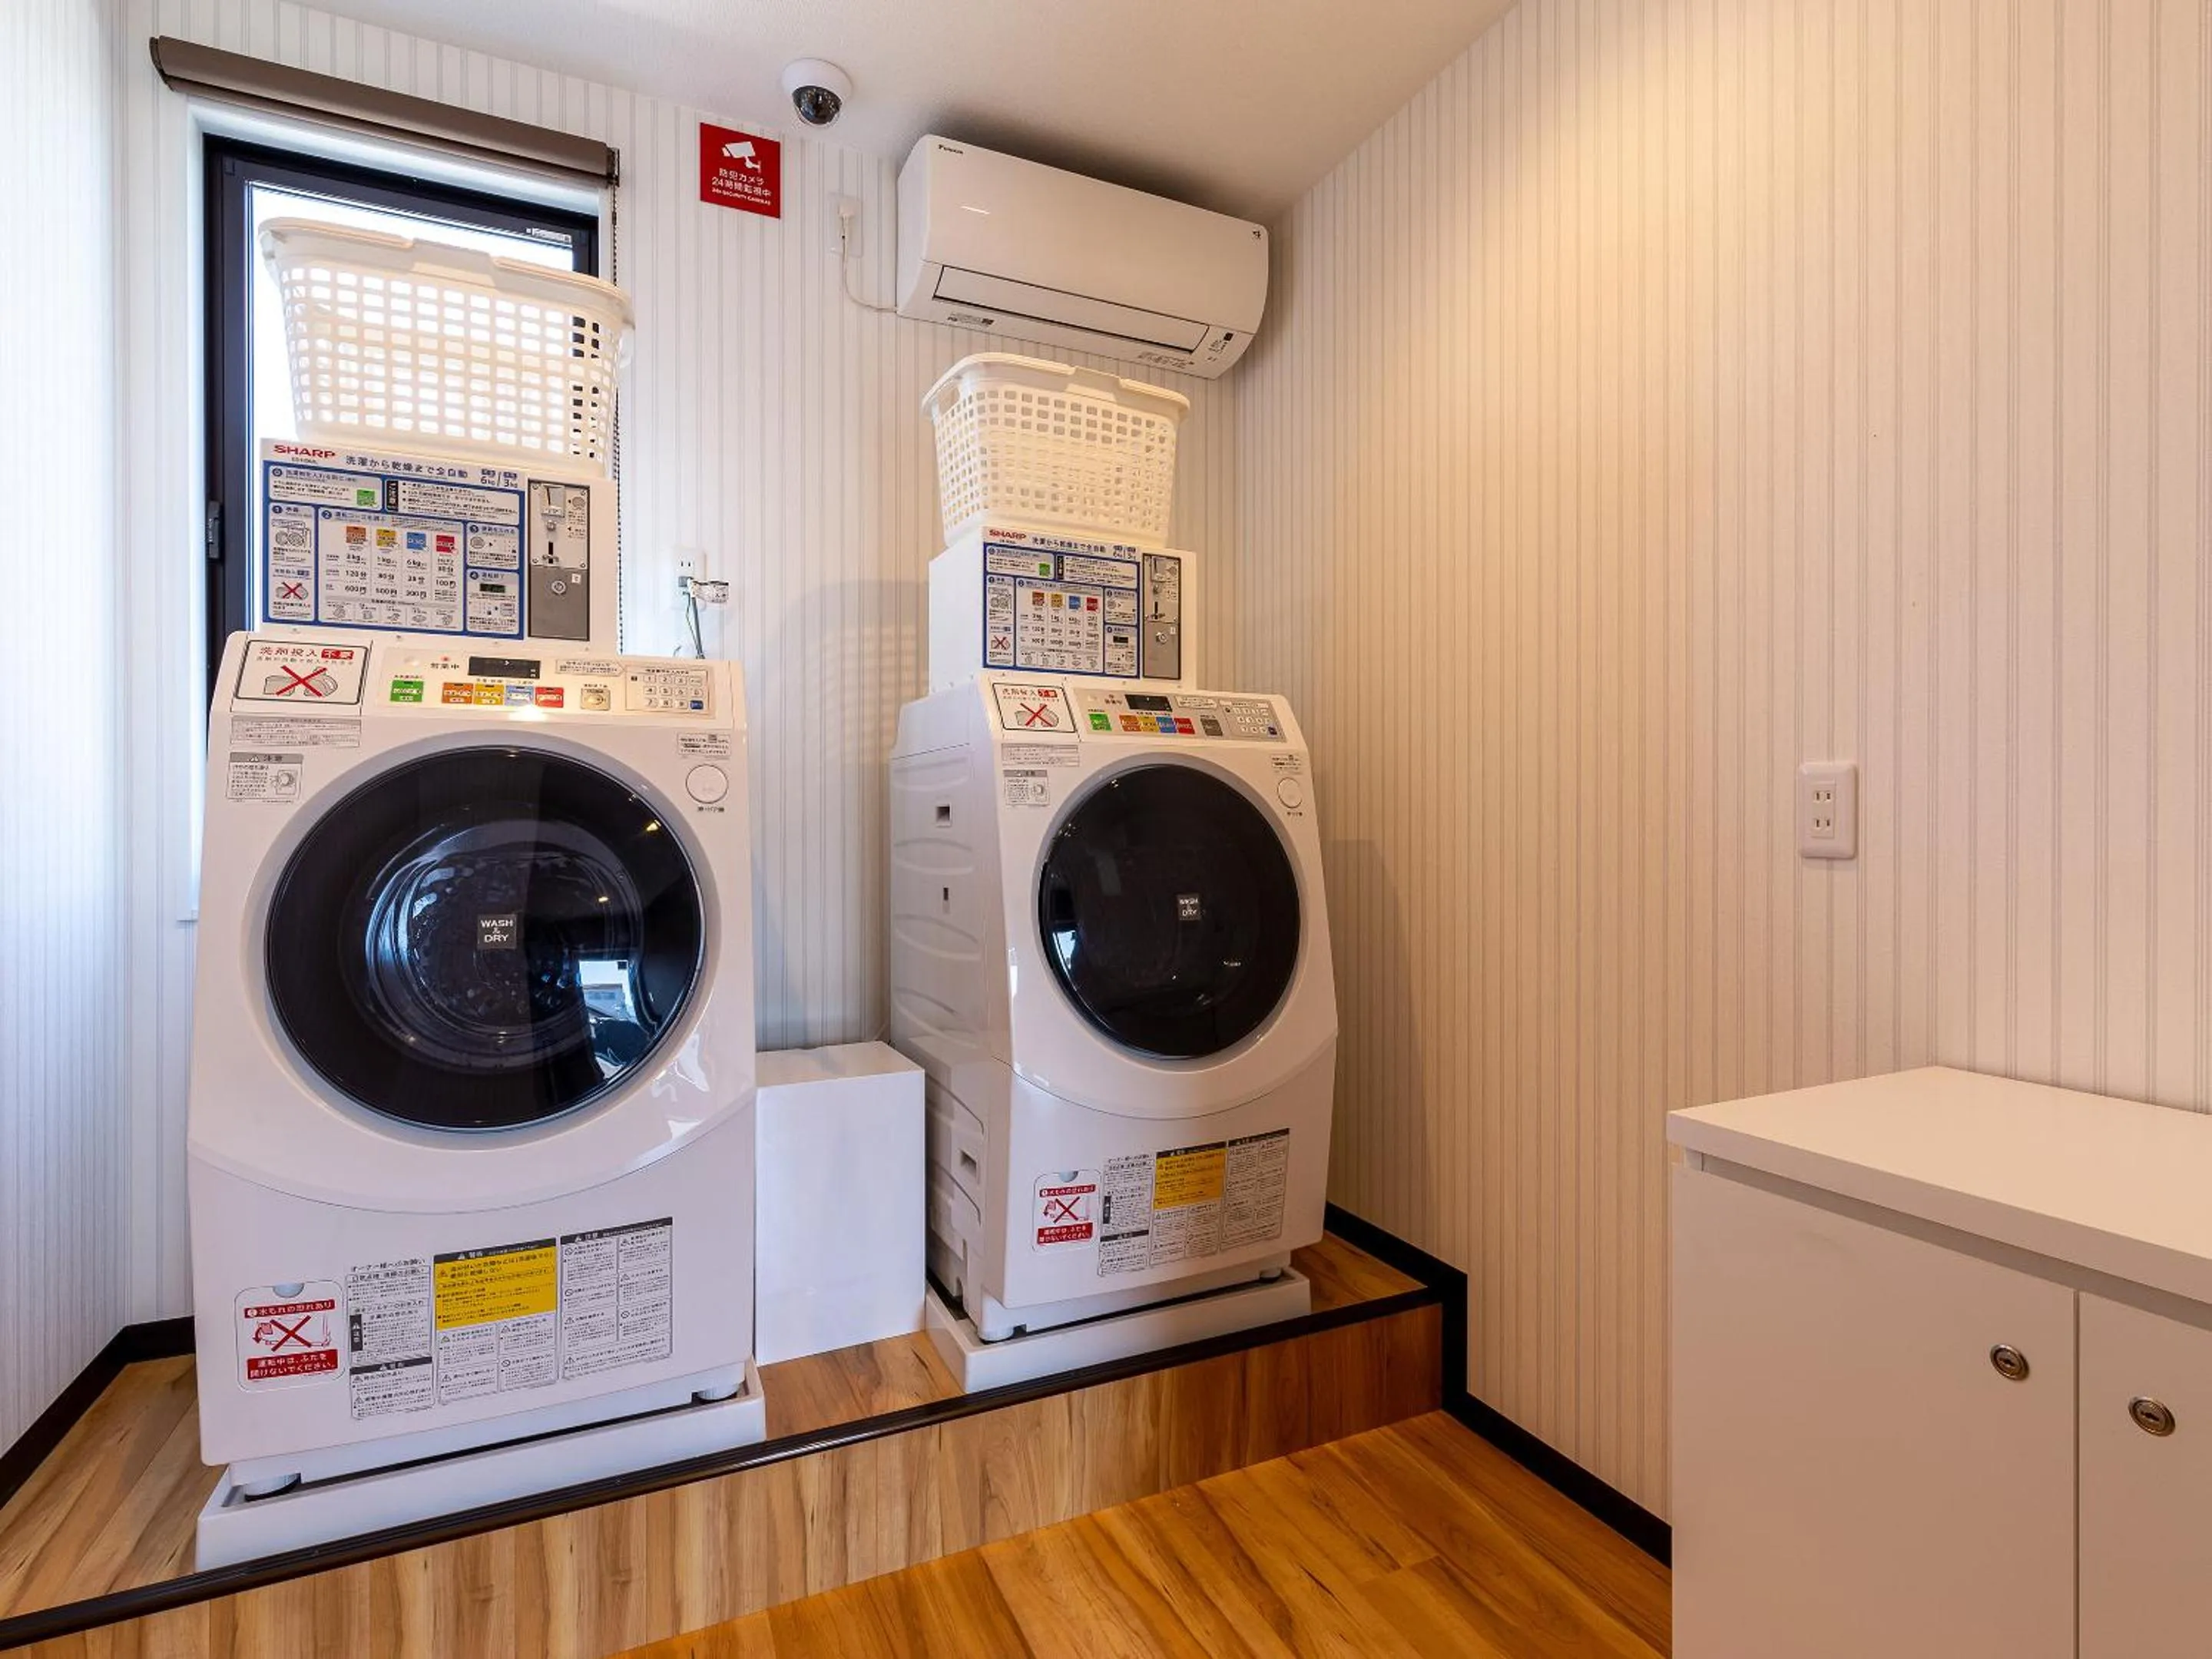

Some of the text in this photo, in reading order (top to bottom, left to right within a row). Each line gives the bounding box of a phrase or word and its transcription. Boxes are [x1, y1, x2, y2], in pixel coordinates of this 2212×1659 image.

[719, 167, 764, 186] 防犯カメラ
[712, 177, 772, 196] 24時間監視中
[273, 445, 336, 459] SHARP
[346, 455, 469, 479] 洗濯から乾燥まで全自動
[989, 529, 1027, 540] SHARP
[260, 647, 317, 657] 洗剤投入
[480, 919, 513, 928] WASH
[484, 934, 508, 942] DRY
